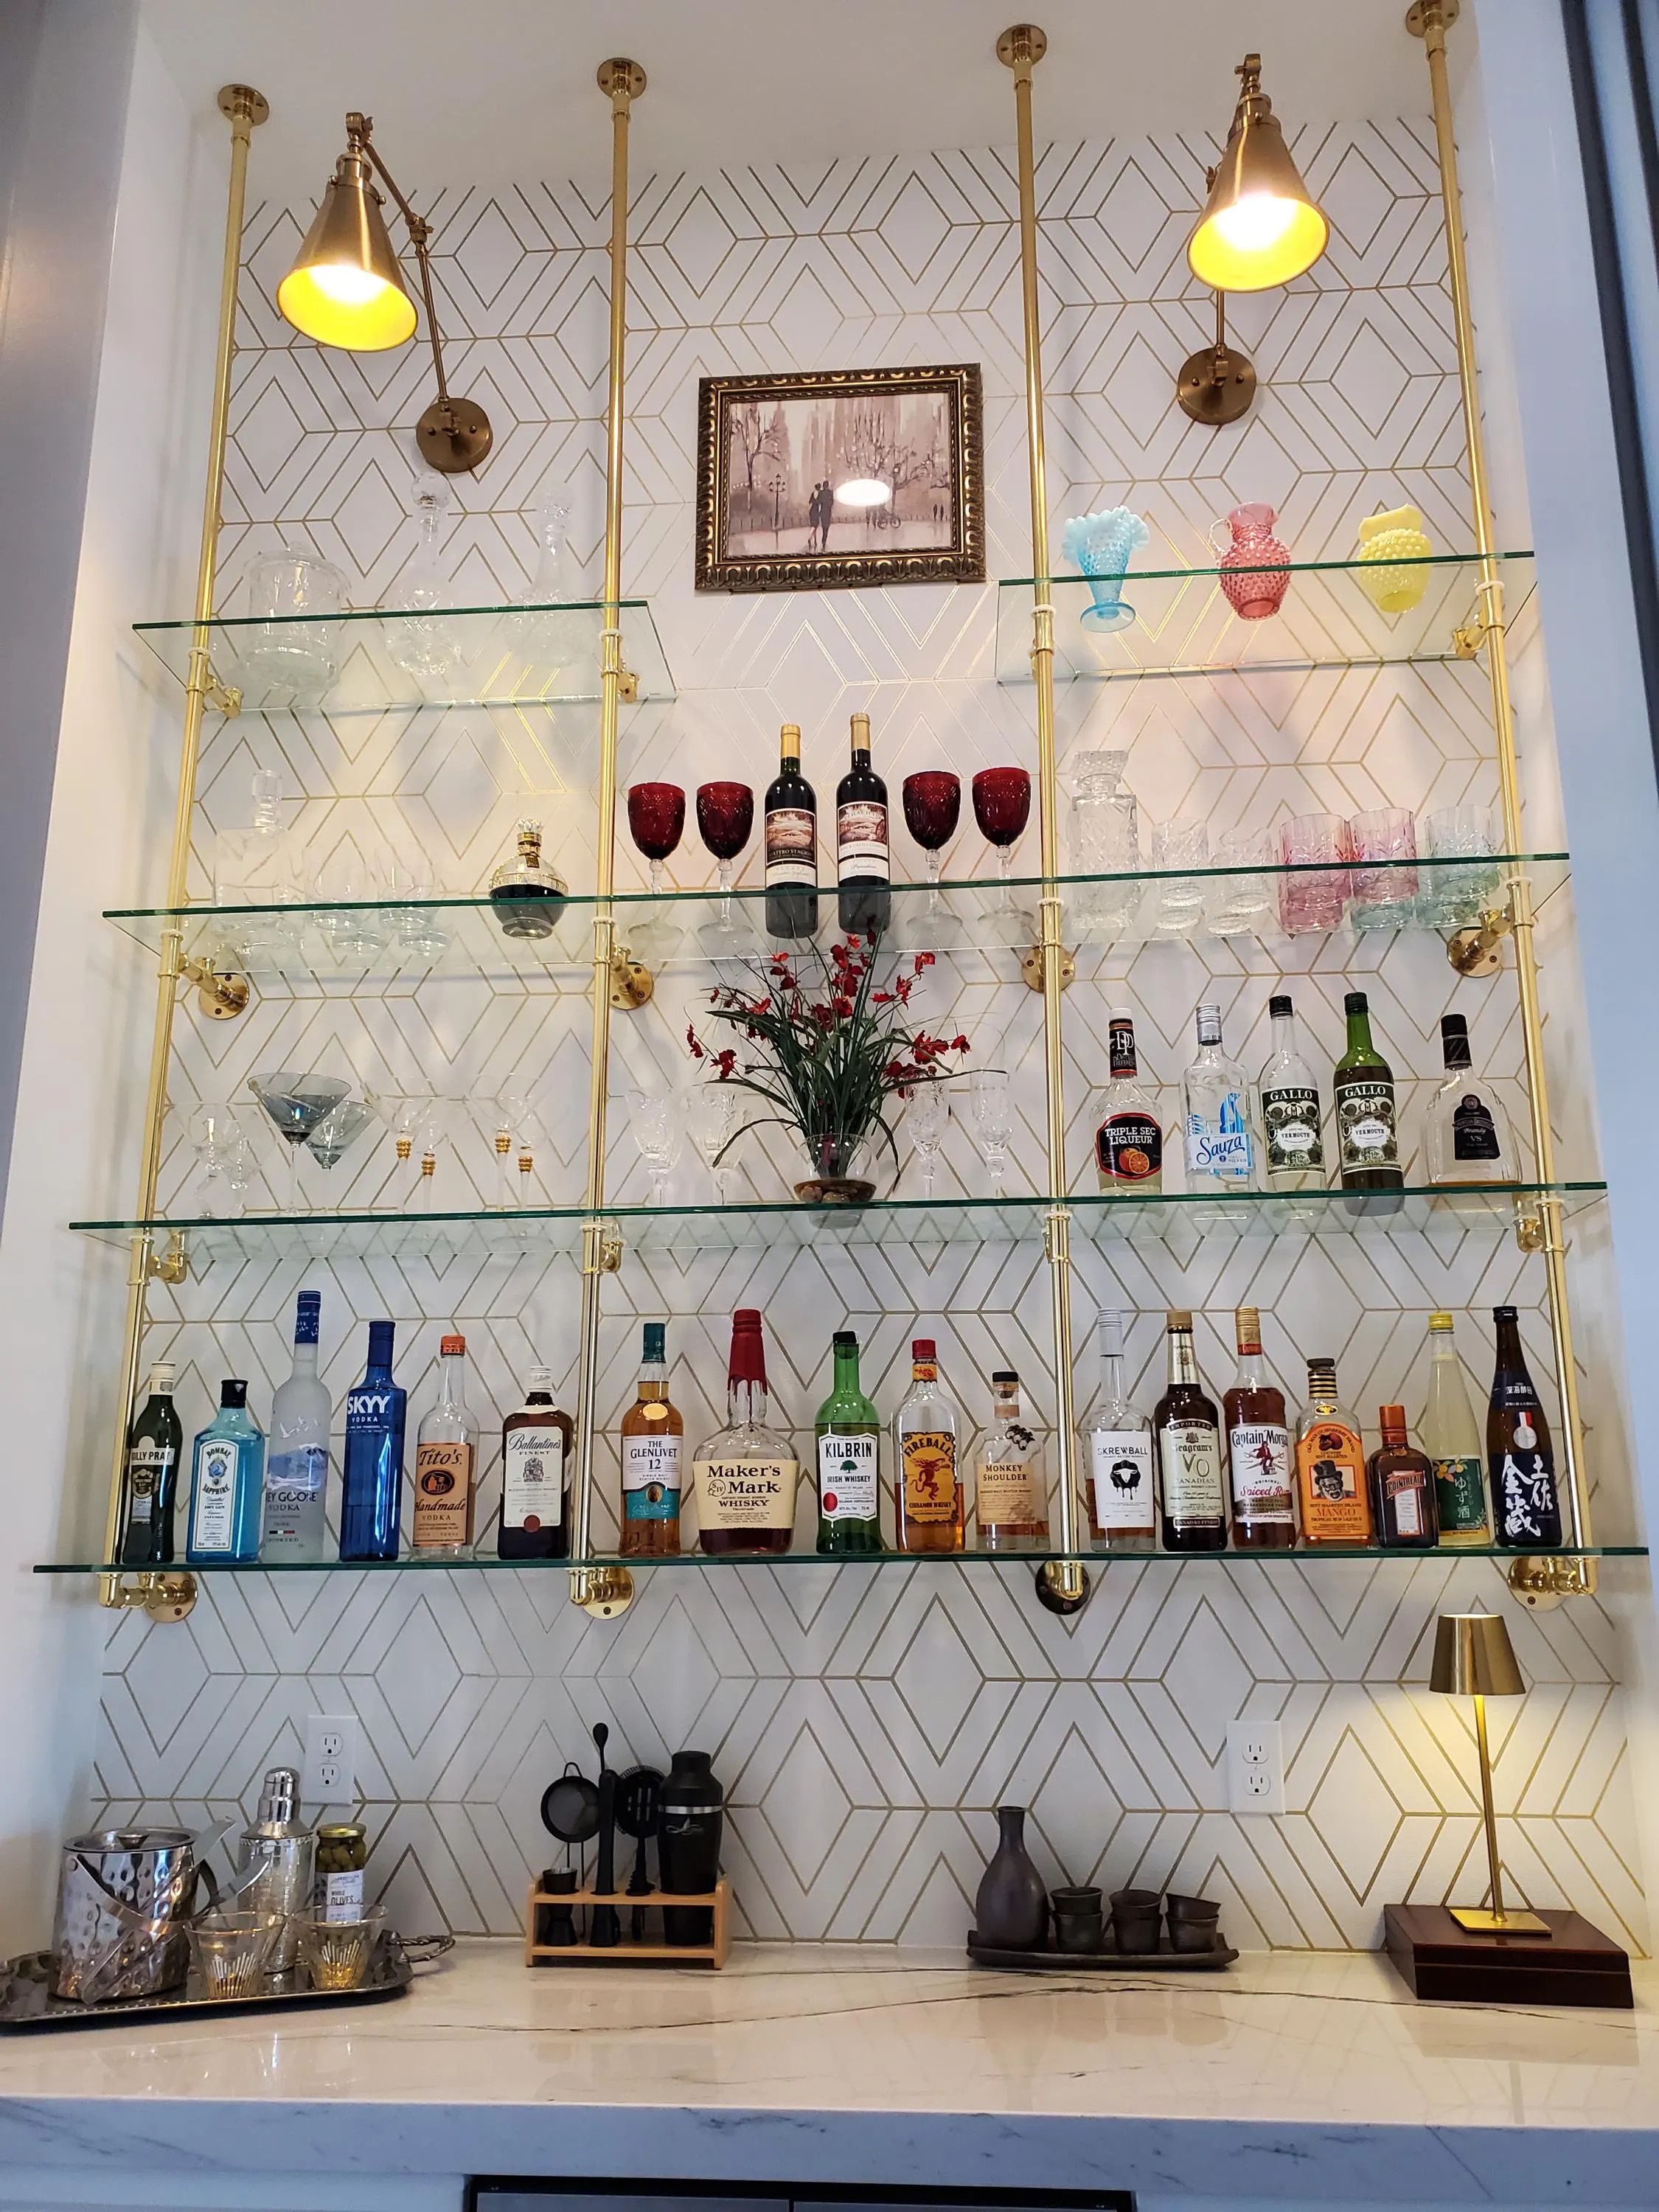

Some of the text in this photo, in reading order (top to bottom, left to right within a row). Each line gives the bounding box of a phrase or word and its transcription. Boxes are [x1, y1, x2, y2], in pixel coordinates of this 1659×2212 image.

[1270, 1089, 1313, 1101] GALLO
[1344, 1085, 1386, 1098] GALLO
[1105, 1127, 1156, 1137] TRIPLE SEC
[1109, 1135, 1153, 1145] LIQUEUR
[1196, 1135, 1246, 1166] Sauza
[347, 1395, 390, 1415] SKYY
[1170, 1420, 1211, 1431] IMPORTED
[507, 1433, 561, 1452] Ballantine's
[647, 1440, 663, 1448] THE
[1232, 1429, 1264, 1448] Captain
[205, 1447, 232, 1459] BOMBAY
[630, 1448, 678, 1459] GLENLIVET
[825, 1442, 872, 1458] KILBRIN
[904, 1437, 953, 1459] FIREBALL
[1097, 1447, 1148, 1455] SKREWBALL
[1172, 1444, 1213, 1454] eagram's
[419, 1447, 462, 1466] Tito's
[648, 1458, 661, 1470] 12
[985, 1464, 1023, 1472] MONKEY
[706, 1465, 781, 1478] Maker's
[983, 1473, 1027, 1481] SHOULDER
[827, 1475, 843, 1484] IRISH
[202, 1482, 232, 1495] SAPPHIRE
[728, 1481, 780, 1494] Mark
[414, 1498, 466, 1512] Handmade
[718, 1499, 770, 1507] WHISKY
[1316, 1508, 1356, 1517] MANGO
[331, 1895, 354, 1905] OLIVES
